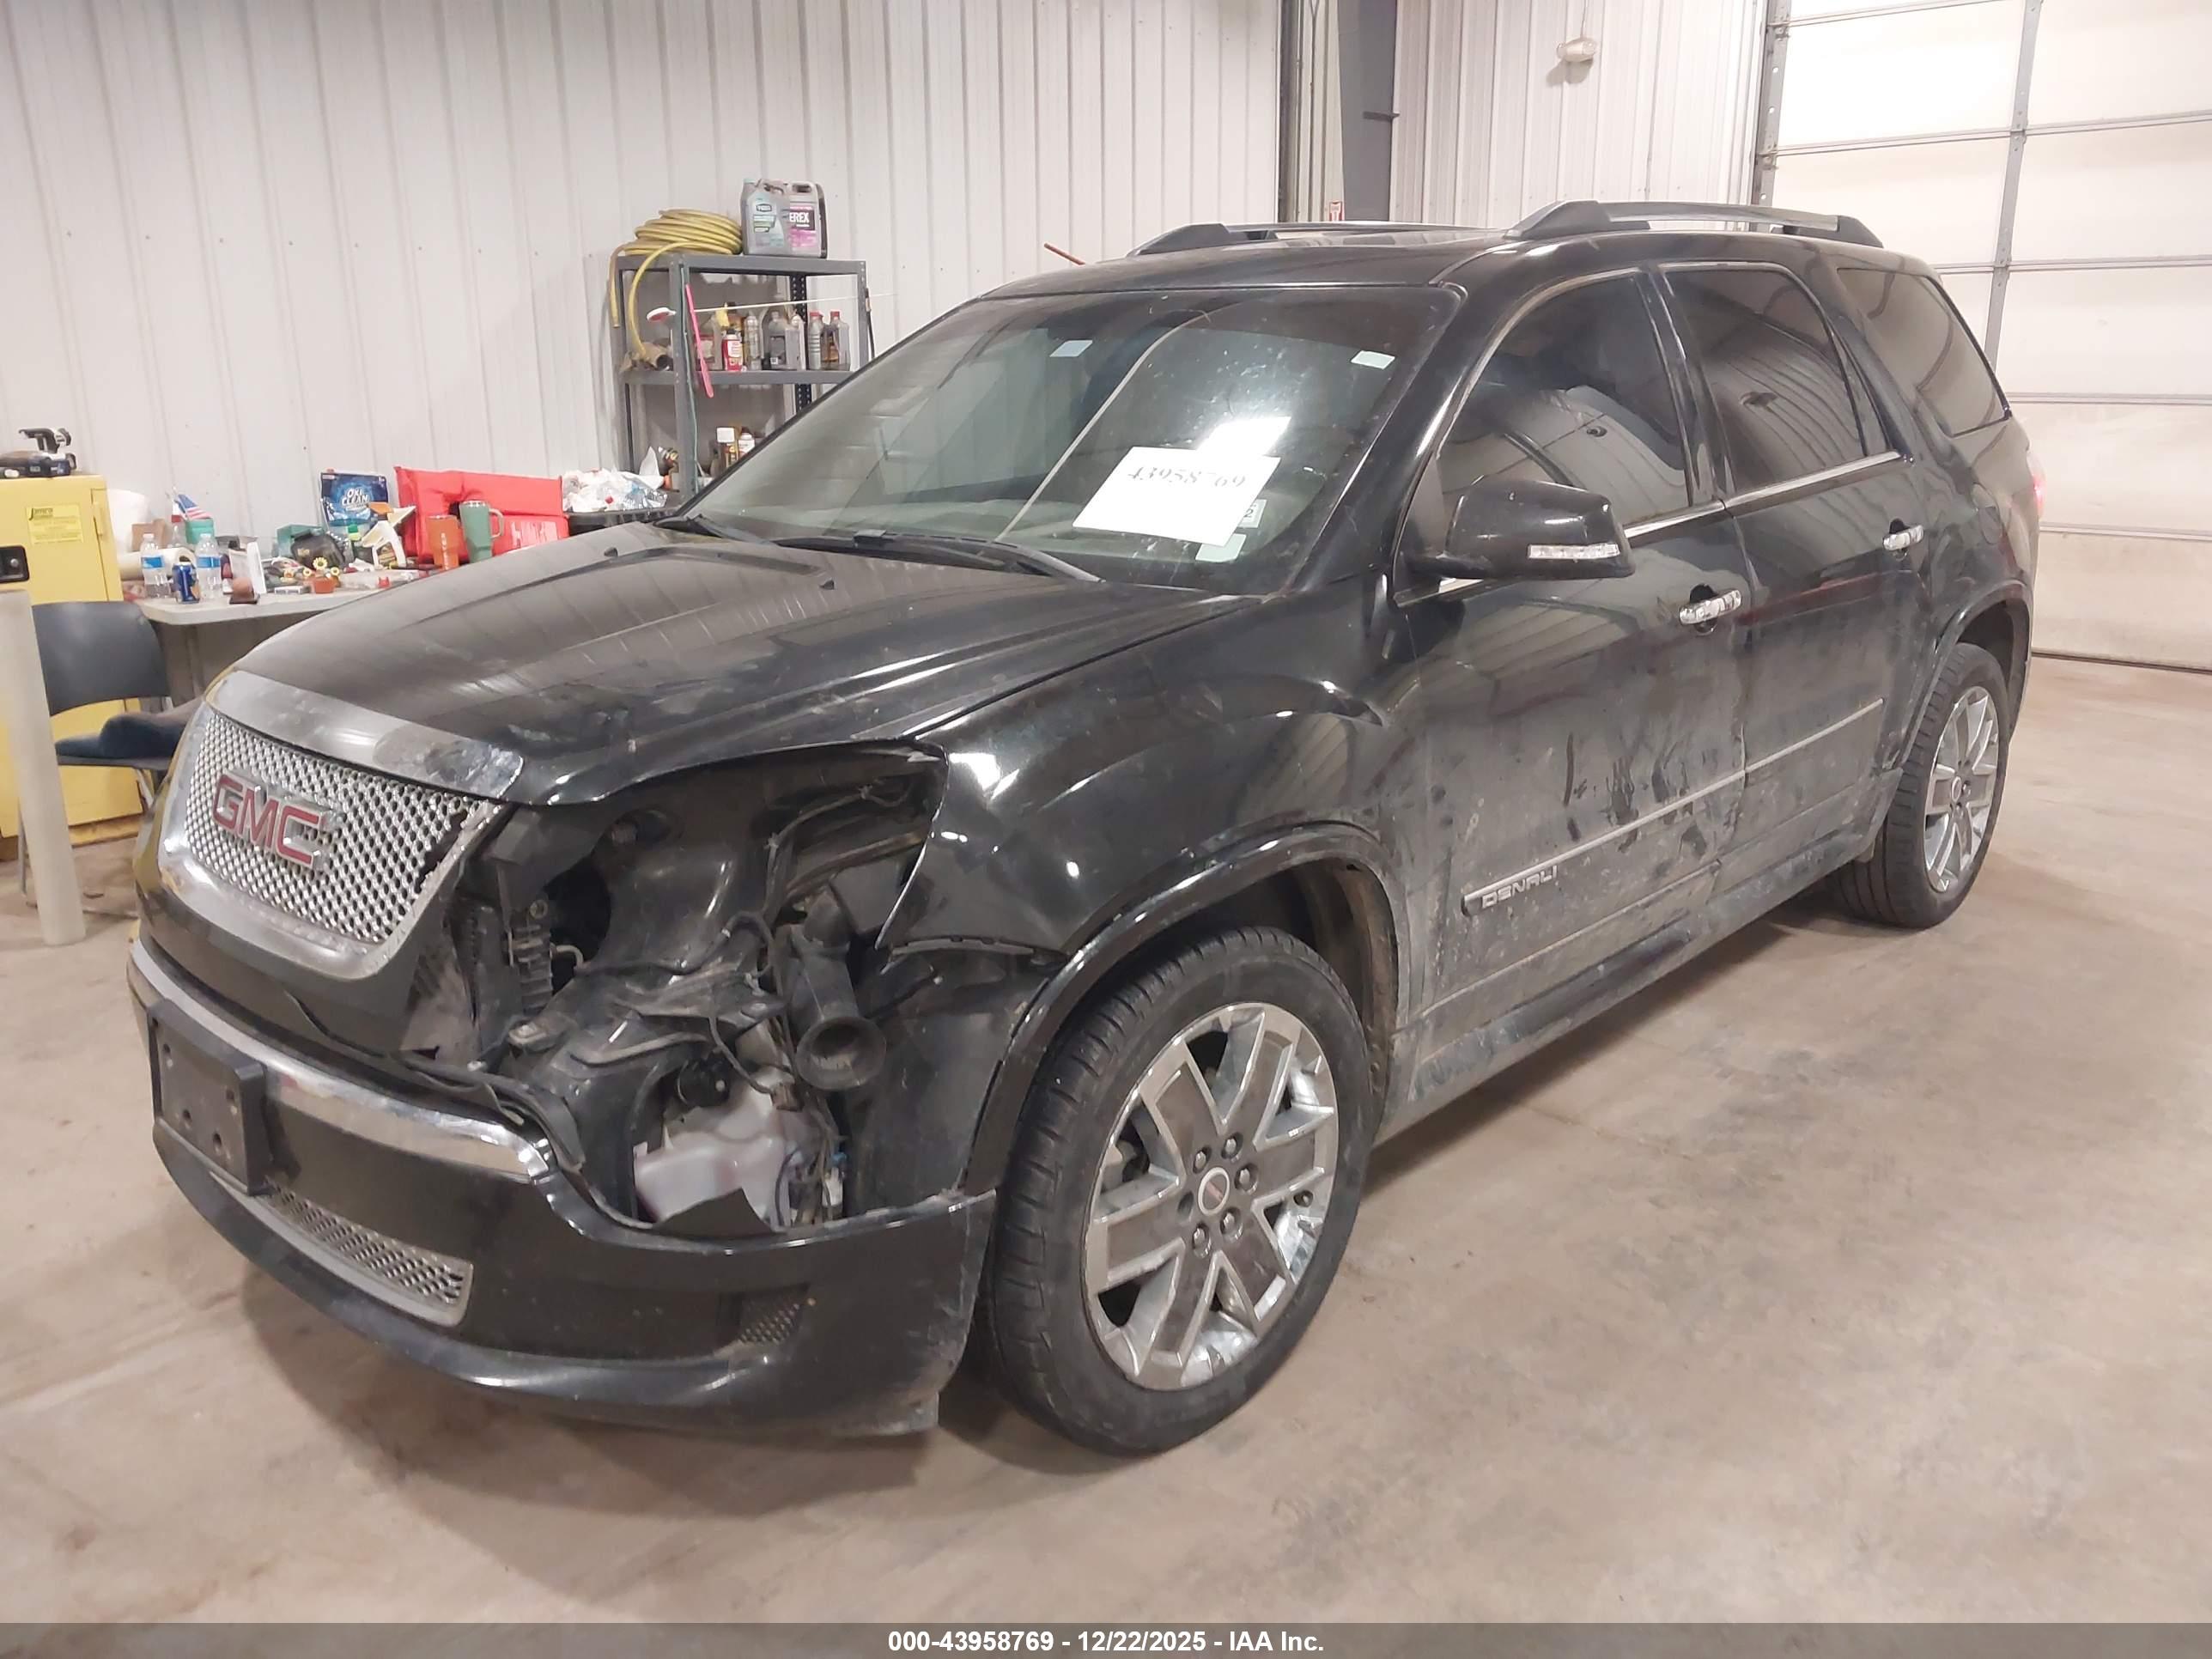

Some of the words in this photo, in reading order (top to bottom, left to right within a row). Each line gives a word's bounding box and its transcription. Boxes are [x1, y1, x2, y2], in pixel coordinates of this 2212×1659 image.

[789, 211, 810, 223] EREX
[346, 487, 363, 499] OXI
[212, 772, 321, 870] GMC
[1481, 865, 1559, 908] DENALI
